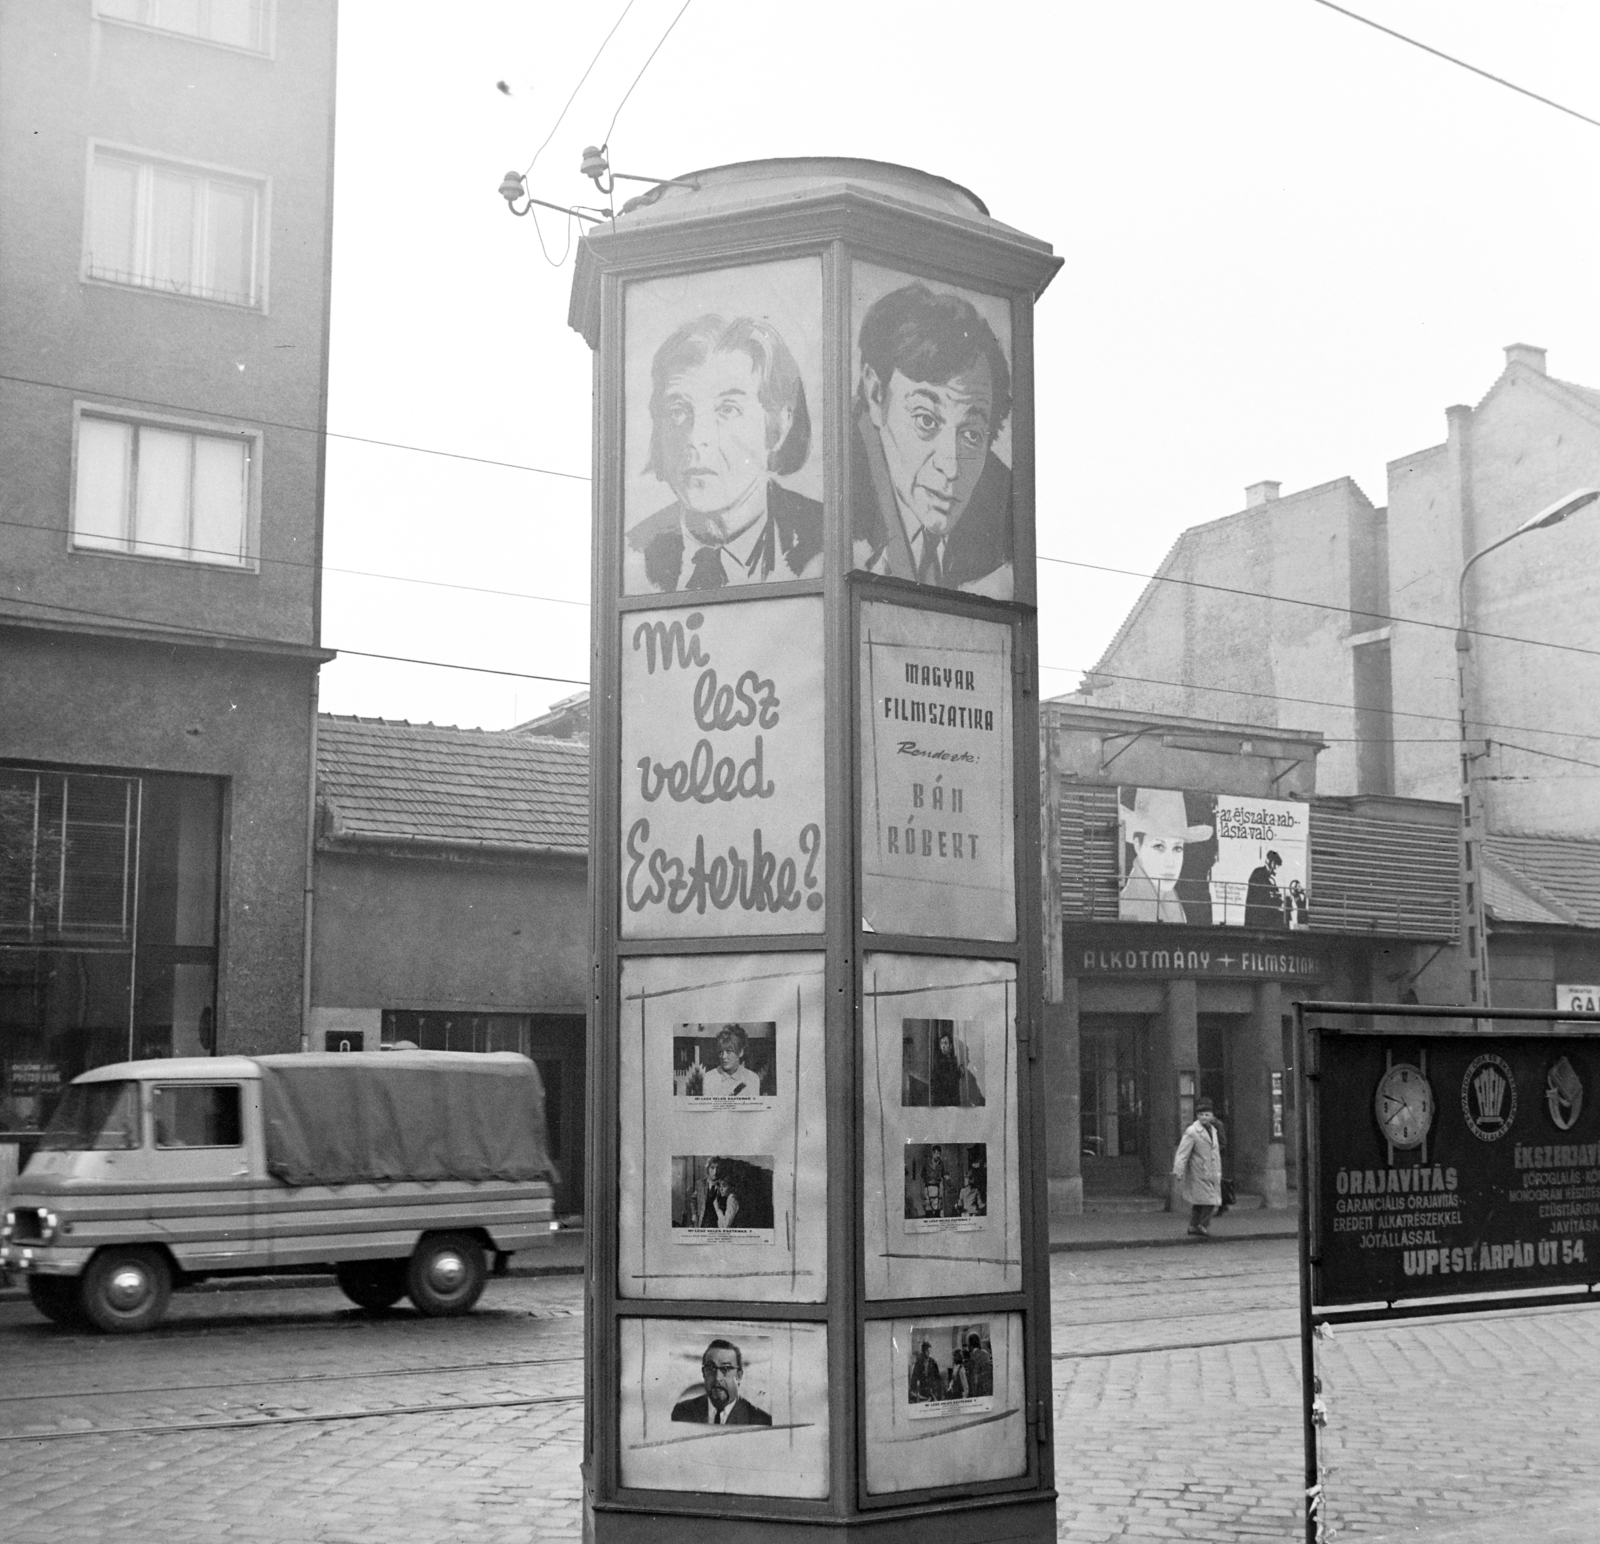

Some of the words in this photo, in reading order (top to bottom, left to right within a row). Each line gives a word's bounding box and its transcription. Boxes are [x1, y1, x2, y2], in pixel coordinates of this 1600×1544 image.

[905, 662, 975, 691] MAGYAR
[693, 667, 781, 732] lesz
[884, 697, 994, 732] FILMSZATIRA
[896, 741, 981, 764] Rendezte:
[637, 734, 776, 804] veled
[912, 773, 963, 813] BÁN
[887, 814, 979, 860] RÓBERT
[625, 817, 824, 916] Eszterke?
[1083, 946, 1210, 970] ALKOTMÁNY
[1570, 996, 1600, 1011] GA
[1336, 1163, 1458, 1194] ÓRAJAVÍTÁS
[1336, 1195, 1405, 1213] GARANCIÁLIS
[1509, 1188, 1563, 1202] MONOGRAM
[1333, 1215, 1373, 1232] EREDETI
[1378, 1211, 1463, 1230] ALKATRÉSZEKKEL
[1549, 1218, 1599, 1234] JAVÍTÁSA
[1479, 1240, 1535, 1271] ÁRPÁD
[1538, 1237, 1558, 1266] ÚT
